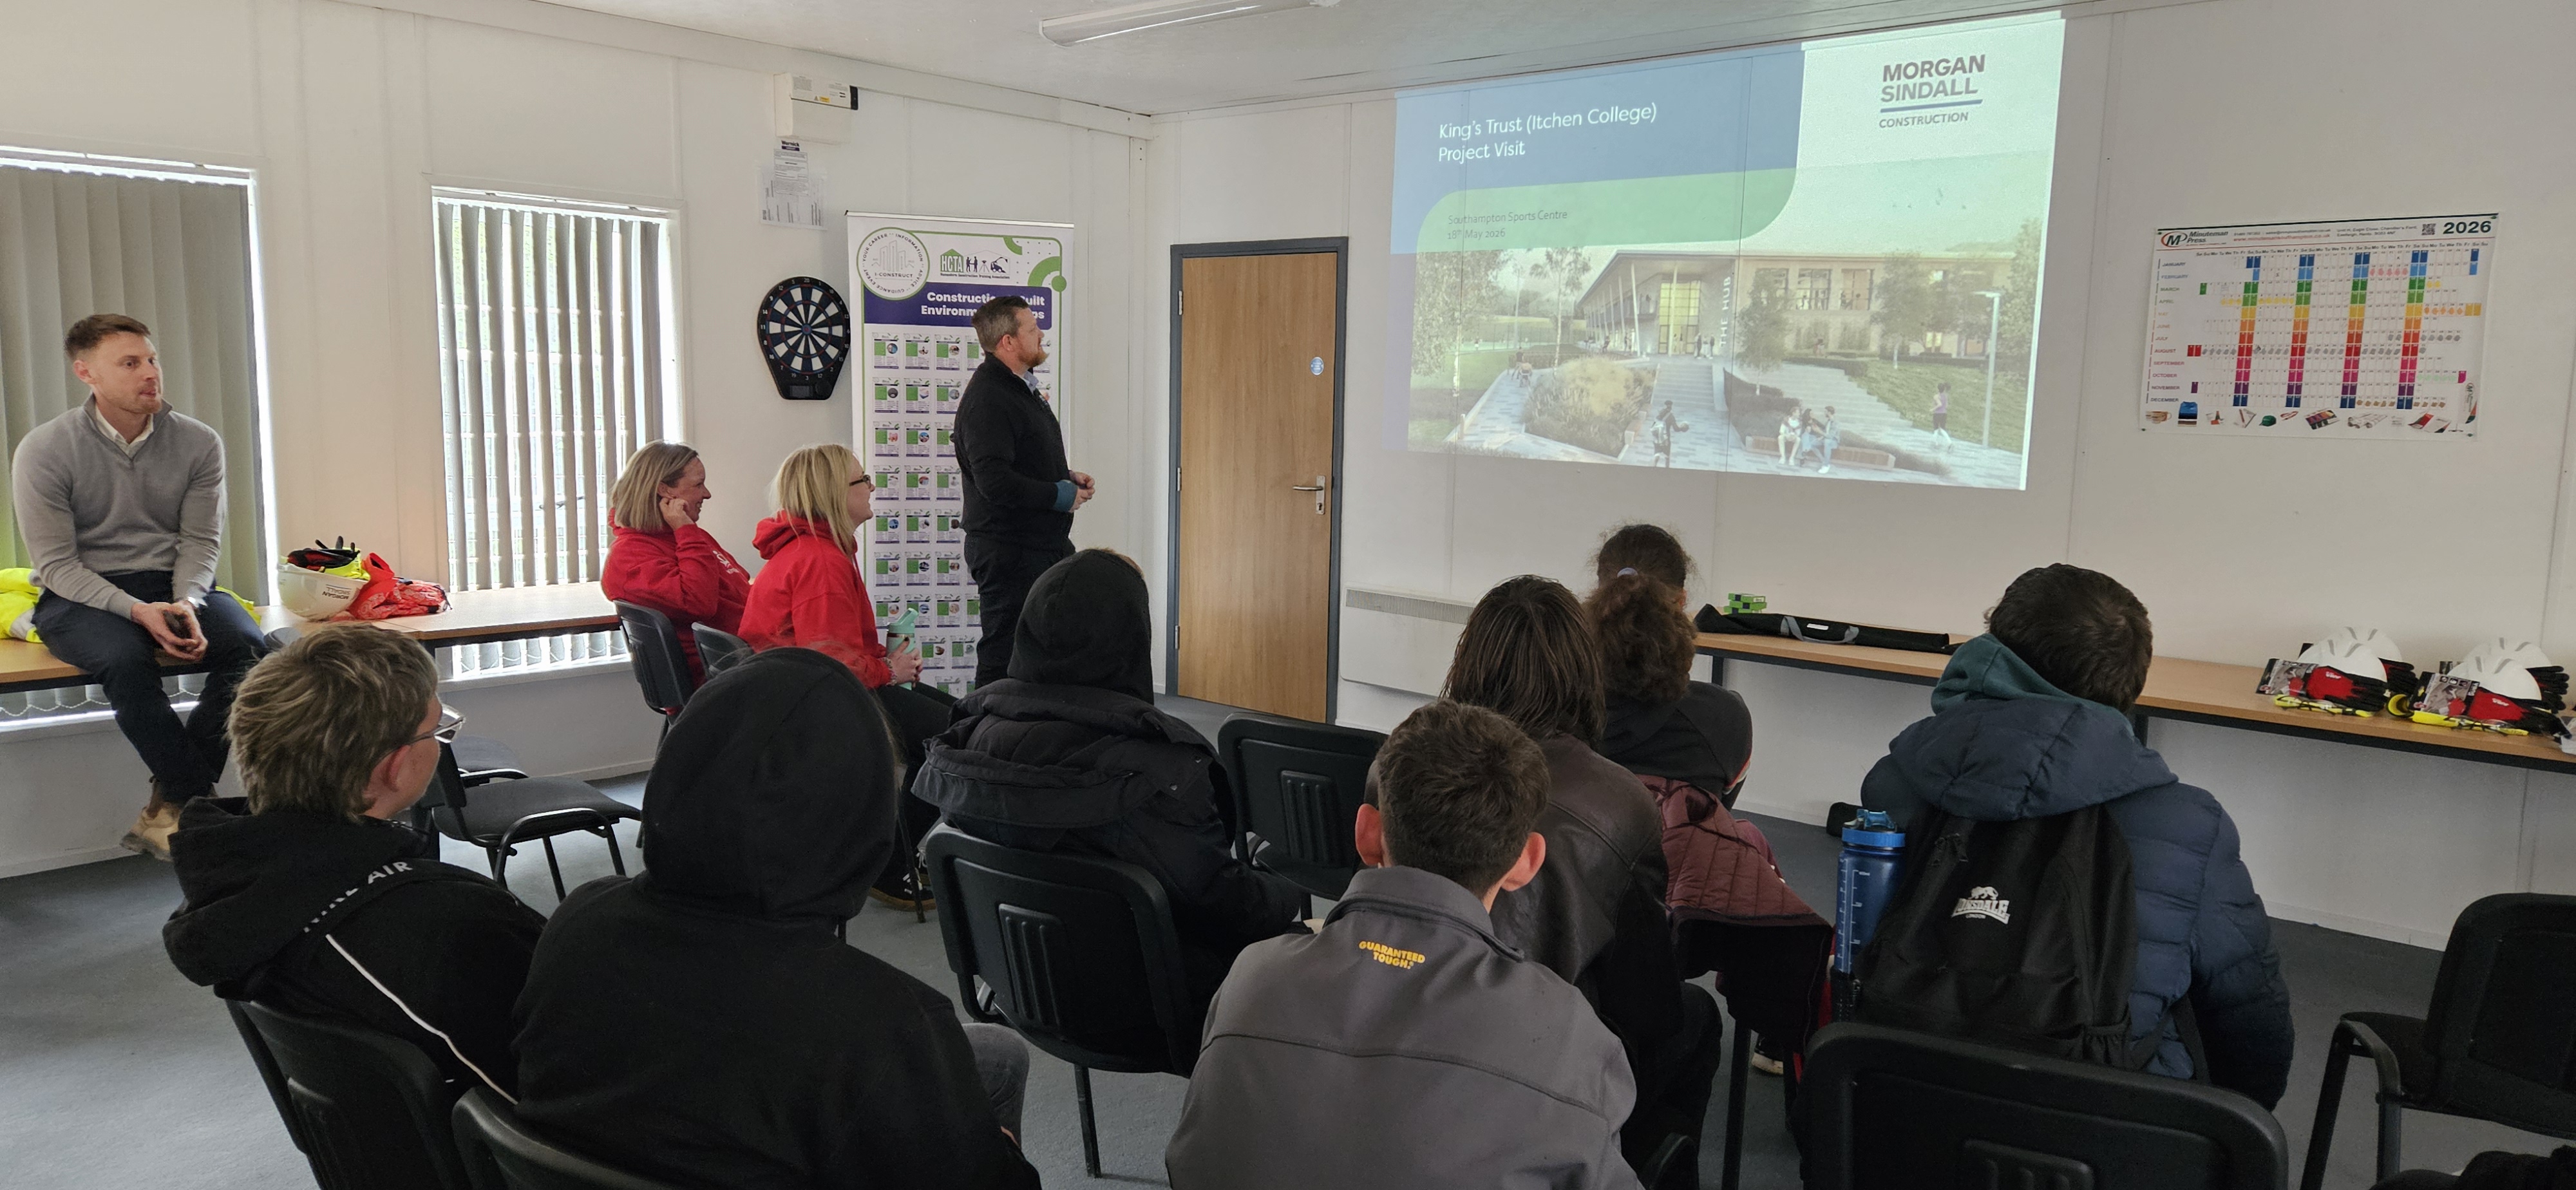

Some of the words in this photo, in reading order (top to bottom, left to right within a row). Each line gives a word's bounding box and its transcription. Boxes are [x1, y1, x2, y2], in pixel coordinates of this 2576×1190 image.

[1883, 54, 1985, 82] MORGAN
[1880, 77, 1978, 102] SINDALL
[1486, 117, 1522, 135] Trust
[1526, 112, 1582, 135] (Itchen
[1587, 102, 1657, 125] College)
[1879, 112, 1969, 128] CONSTRUCTION
[1439, 144, 1490, 164] Project
[1494, 140, 1526, 157] Visit
[1448, 214, 1506, 225] Southampton
[1508, 212, 1536, 223] Sports
[1537, 210, 1567, 220] Centre
[1464, 229, 1482, 240] May
[1485, 228, 1506, 238] 2026
[2443, 221, 2492, 234] 2026
[869, 233, 887, 246] CAREER
[896, 233, 923, 261] INFORMATION
[942, 255, 963, 272] HCTA
[864, 269, 876, 285] EVENT
[911, 269, 923, 287] ADVICE
[876, 285, 905, 294] GUIDANCE
[1721, 276, 1731, 310] HUB
[927, 292, 996, 303] Constructi
[1020, 294, 1045, 306] uilt
[921, 305, 978, 316] Environm
[1719, 317, 1728, 347] THE
[322, 591, 349, 600] MORGAN
[368, 861, 413, 884] AIR
[1359, 941, 1425, 963] GUARANTEED
